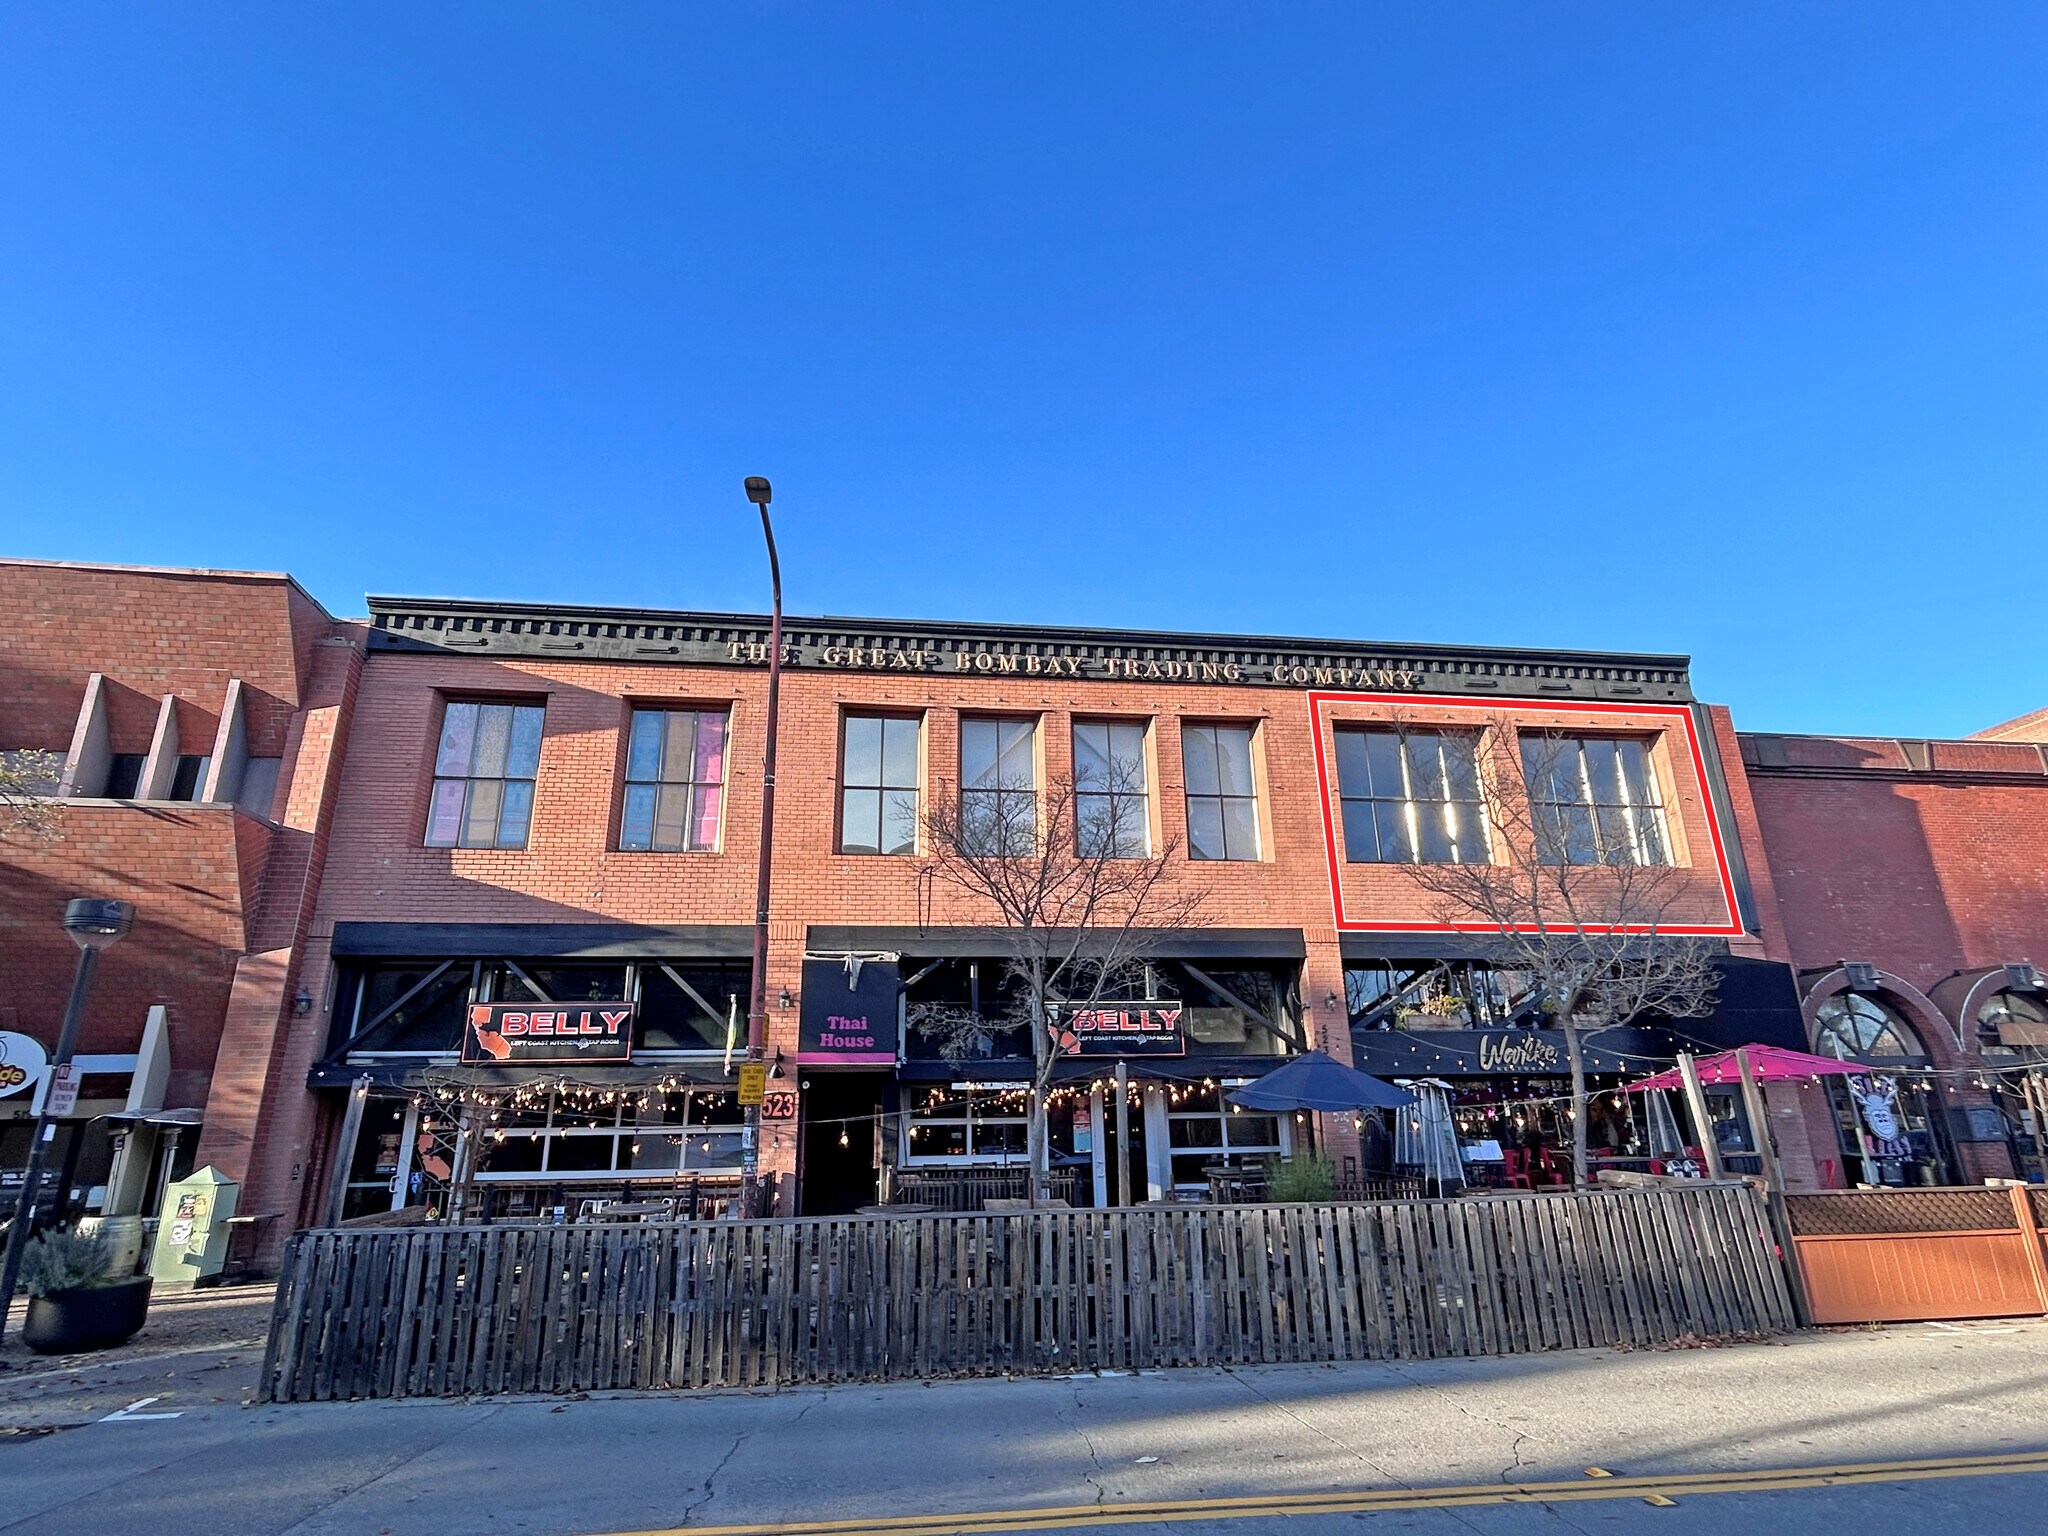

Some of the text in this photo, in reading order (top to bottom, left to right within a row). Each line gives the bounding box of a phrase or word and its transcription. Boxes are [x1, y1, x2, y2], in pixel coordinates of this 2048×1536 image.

[727, 641, 1413, 687] THE GREAT BOMBAY TRADING COMPANY
[501, 1011, 630, 1036] BELLY
[827, 1016, 868, 1030] Thai
[1073, 1010, 1181, 1031] BELLY
[820, 1033, 875, 1047] House
[762, 1094, 794, 1117] 523
